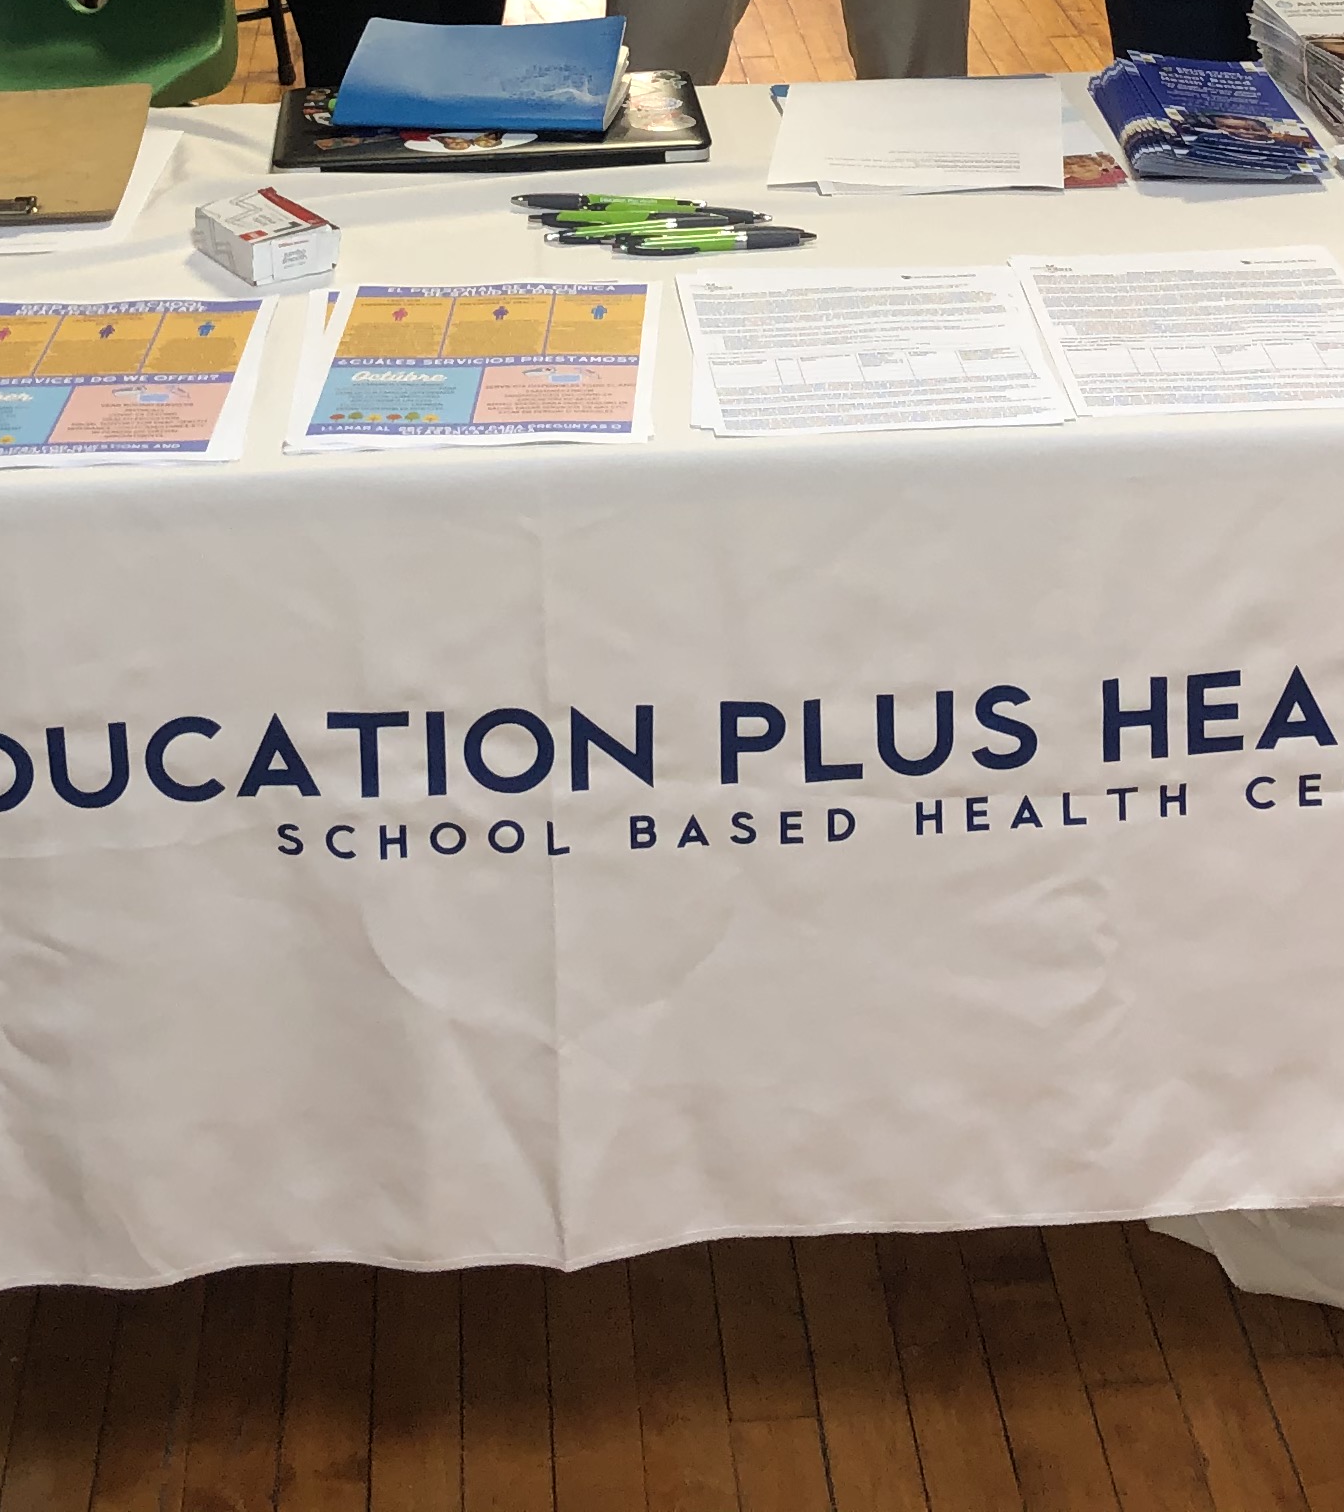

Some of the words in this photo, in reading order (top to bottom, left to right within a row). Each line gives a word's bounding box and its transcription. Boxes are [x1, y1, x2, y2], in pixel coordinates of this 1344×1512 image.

[0, 376, 85, 385] SERVICES
[422, 357, 515, 365] SERVICIOS
[720, 686, 1037, 784] PLUS
[276, 821, 568, 861] SCHOOL
[630, 808, 858, 849] BASED
[916, 788, 1186, 835] HEALTH
